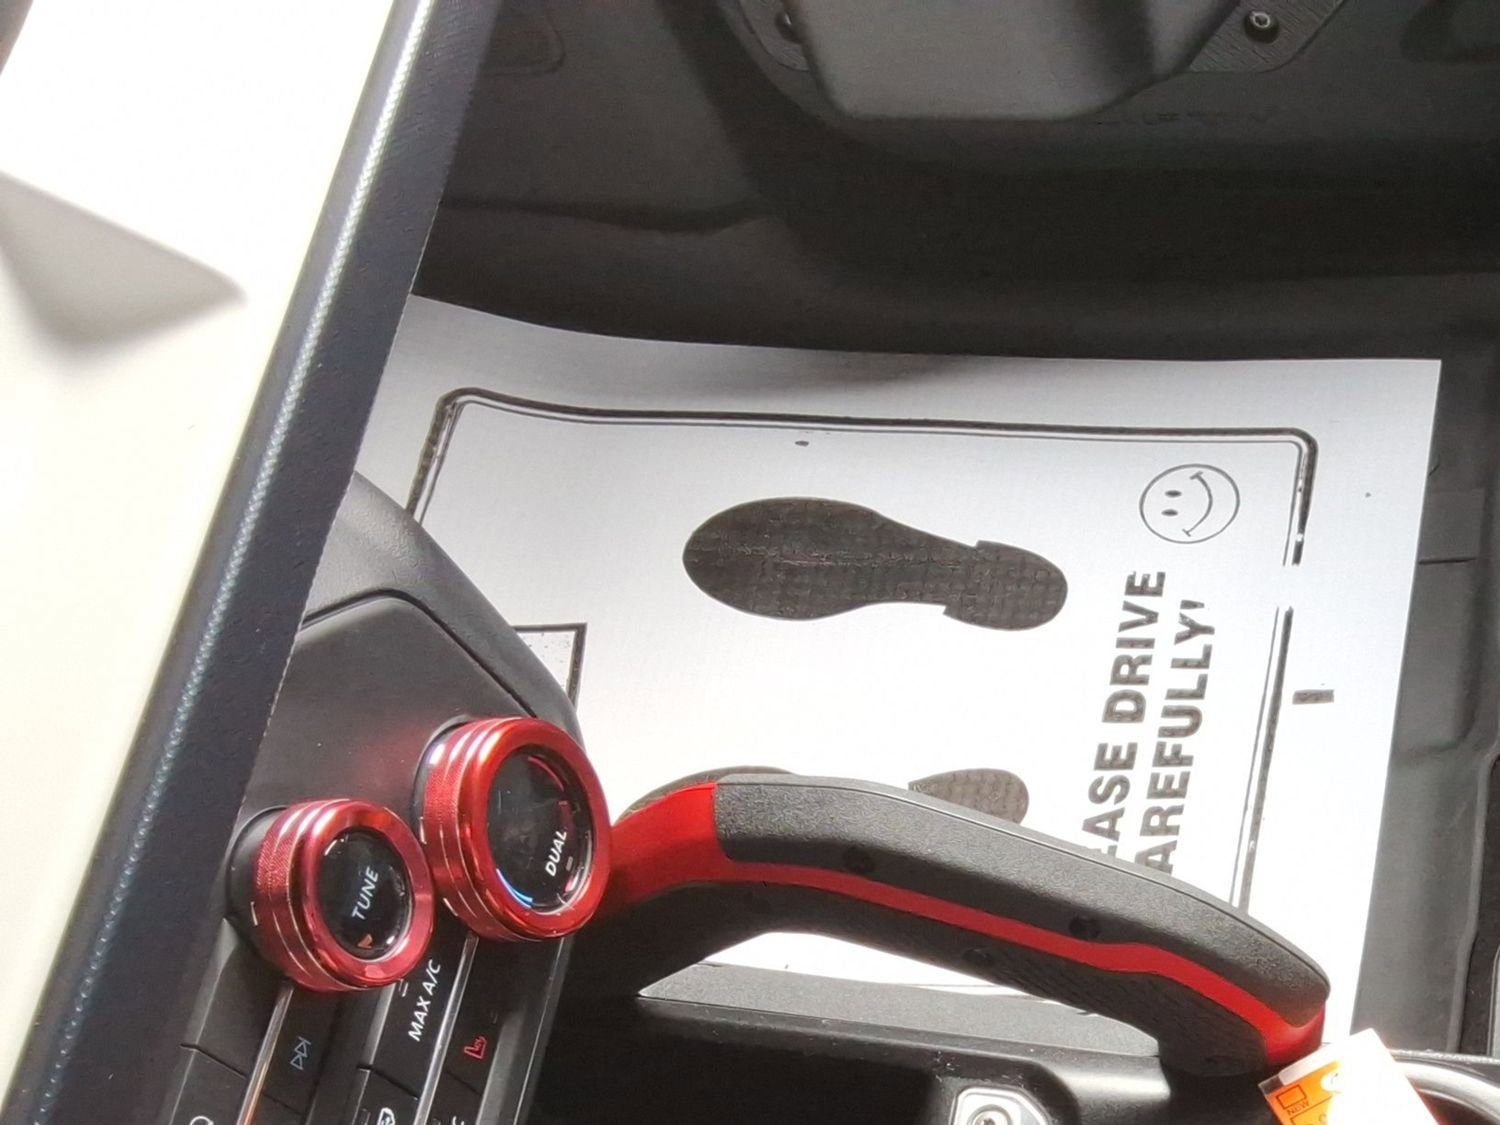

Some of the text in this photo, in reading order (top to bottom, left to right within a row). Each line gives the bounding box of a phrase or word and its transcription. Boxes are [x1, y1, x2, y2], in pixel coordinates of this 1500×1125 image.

[1101, 571, 1166, 723] DRIVE
[545, 830, 568, 877] DUAL
[352, 866, 379, 920] TUNE
[408, 959, 441, 1042] MAX A/C
